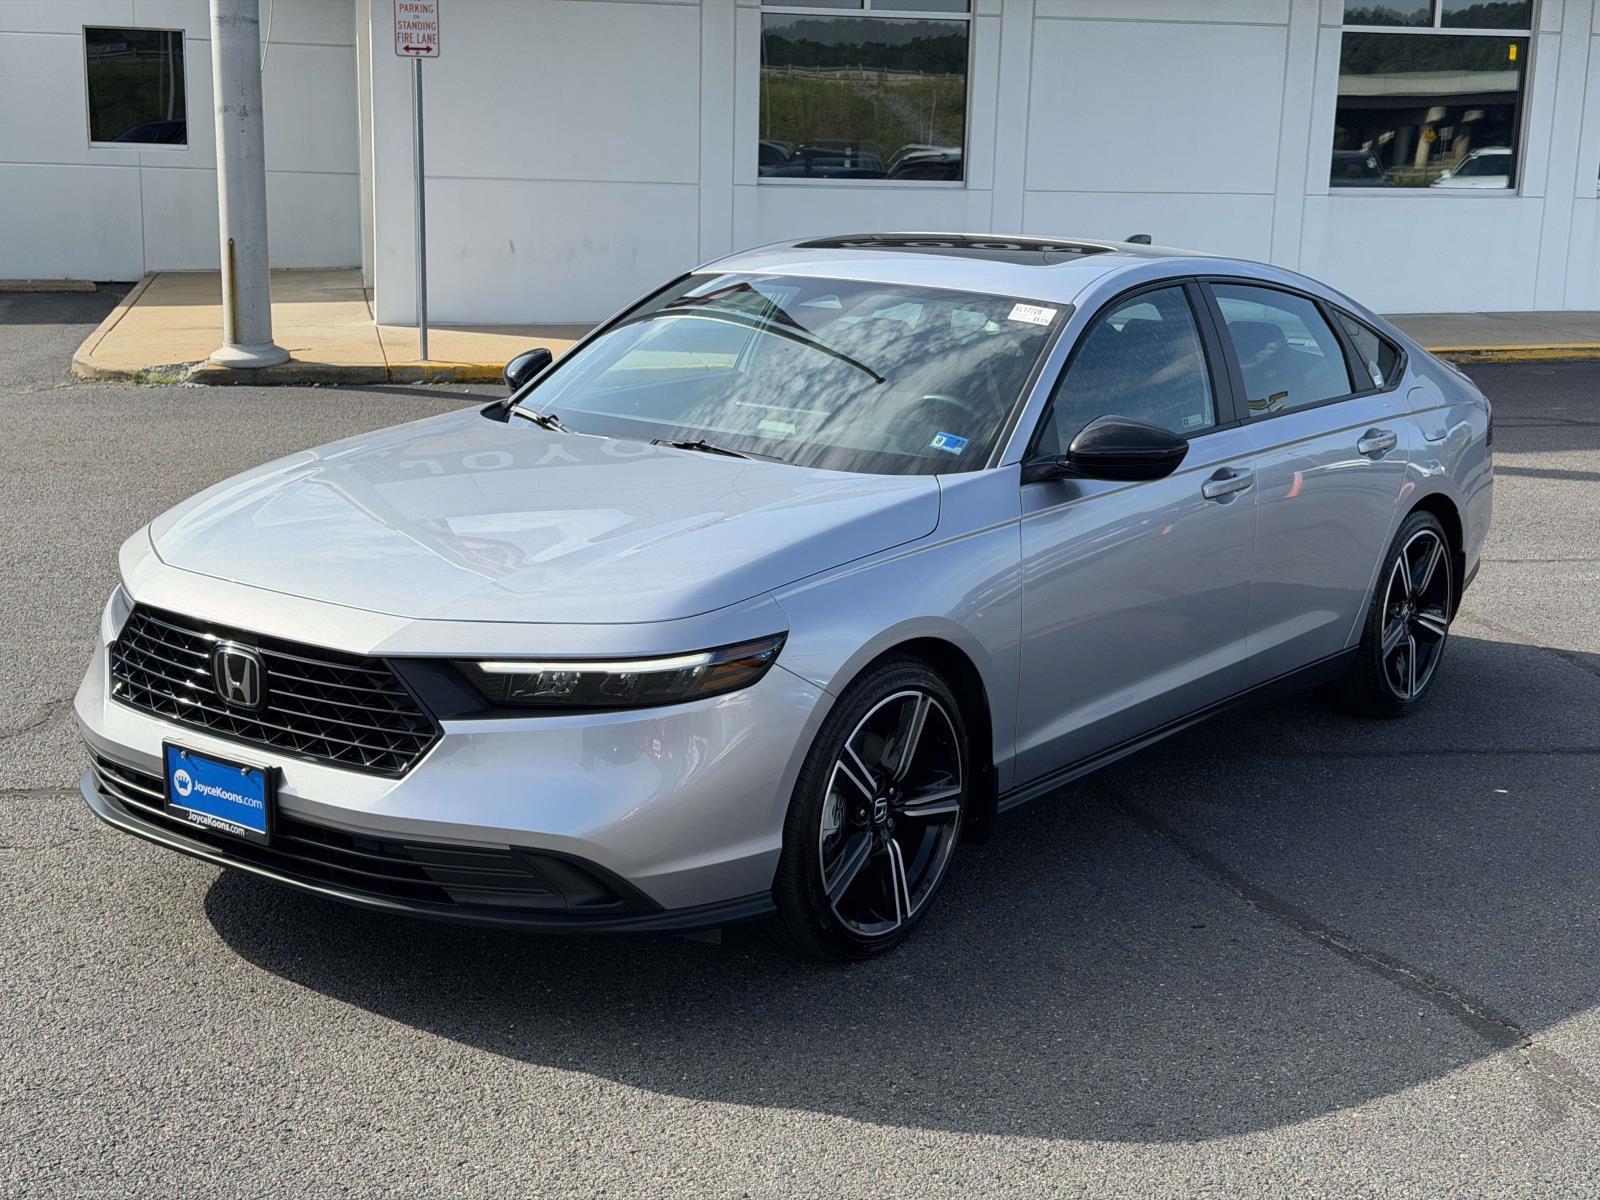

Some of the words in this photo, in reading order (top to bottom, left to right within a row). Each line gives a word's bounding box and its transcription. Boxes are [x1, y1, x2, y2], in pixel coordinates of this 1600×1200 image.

[399, 3, 434, 14] PARKING
[397, 20, 437, 31] STANDING
[397, 32, 414, 44] FIRE
[416, 33, 437, 45] LANE
[193, 780, 263, 810] JoyceKoons.com
[187, 809, 246, 837] JoyceKoons.com
